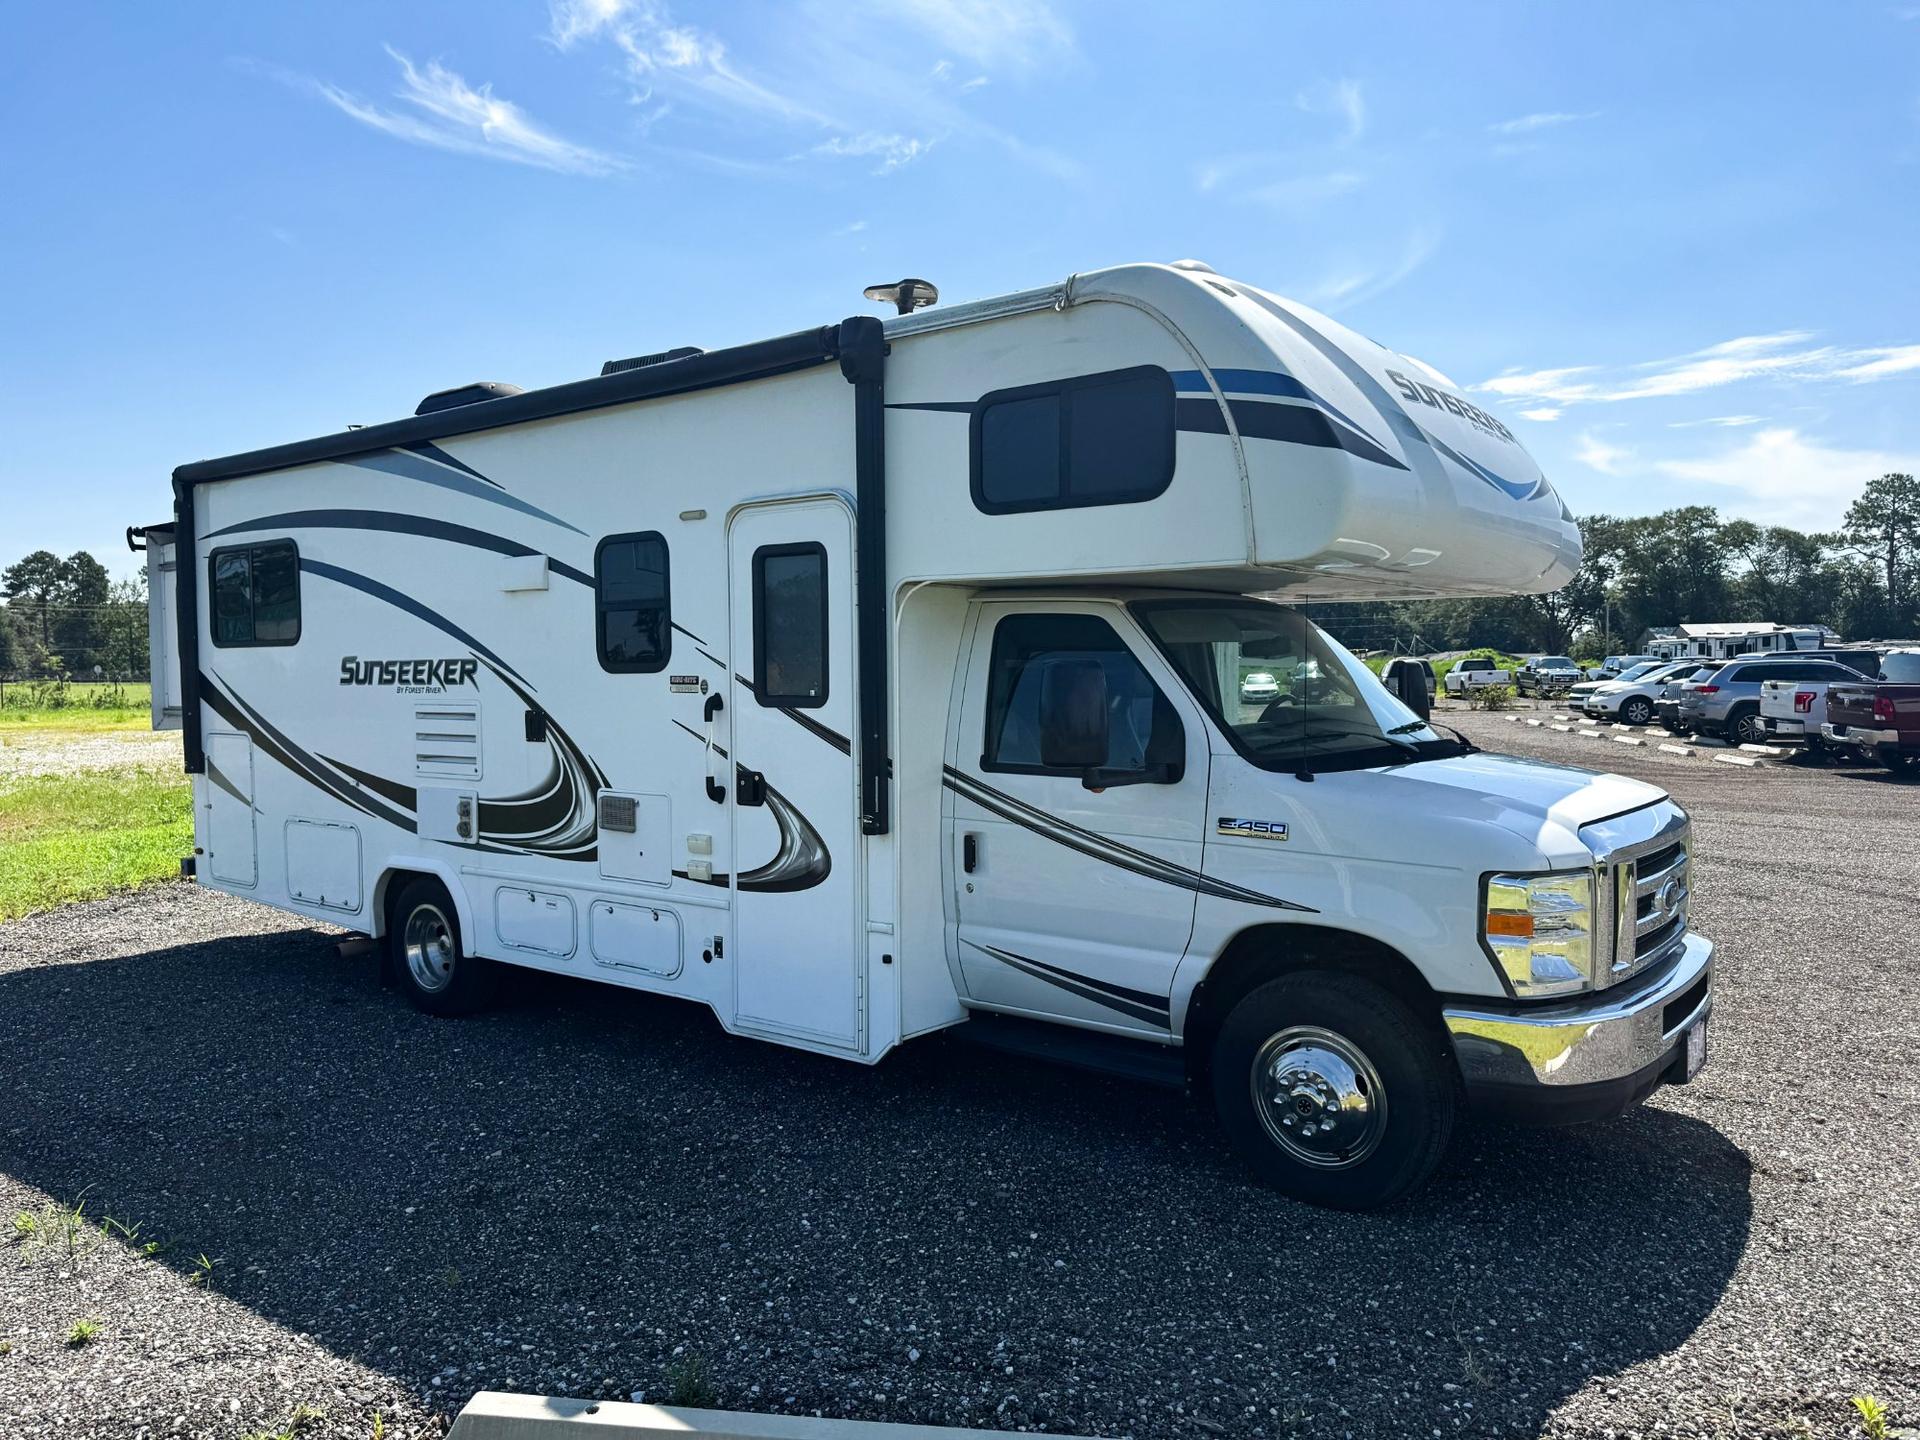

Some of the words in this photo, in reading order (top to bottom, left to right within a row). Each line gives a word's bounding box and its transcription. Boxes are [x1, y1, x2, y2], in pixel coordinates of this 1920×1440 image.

[340, 655, 480, 692] SUNSEEKER
[405, 686, 425, 694] FOREST
[425, 686, 442, 694] RIVER
[1218, 817, 1286, 834] E-450
